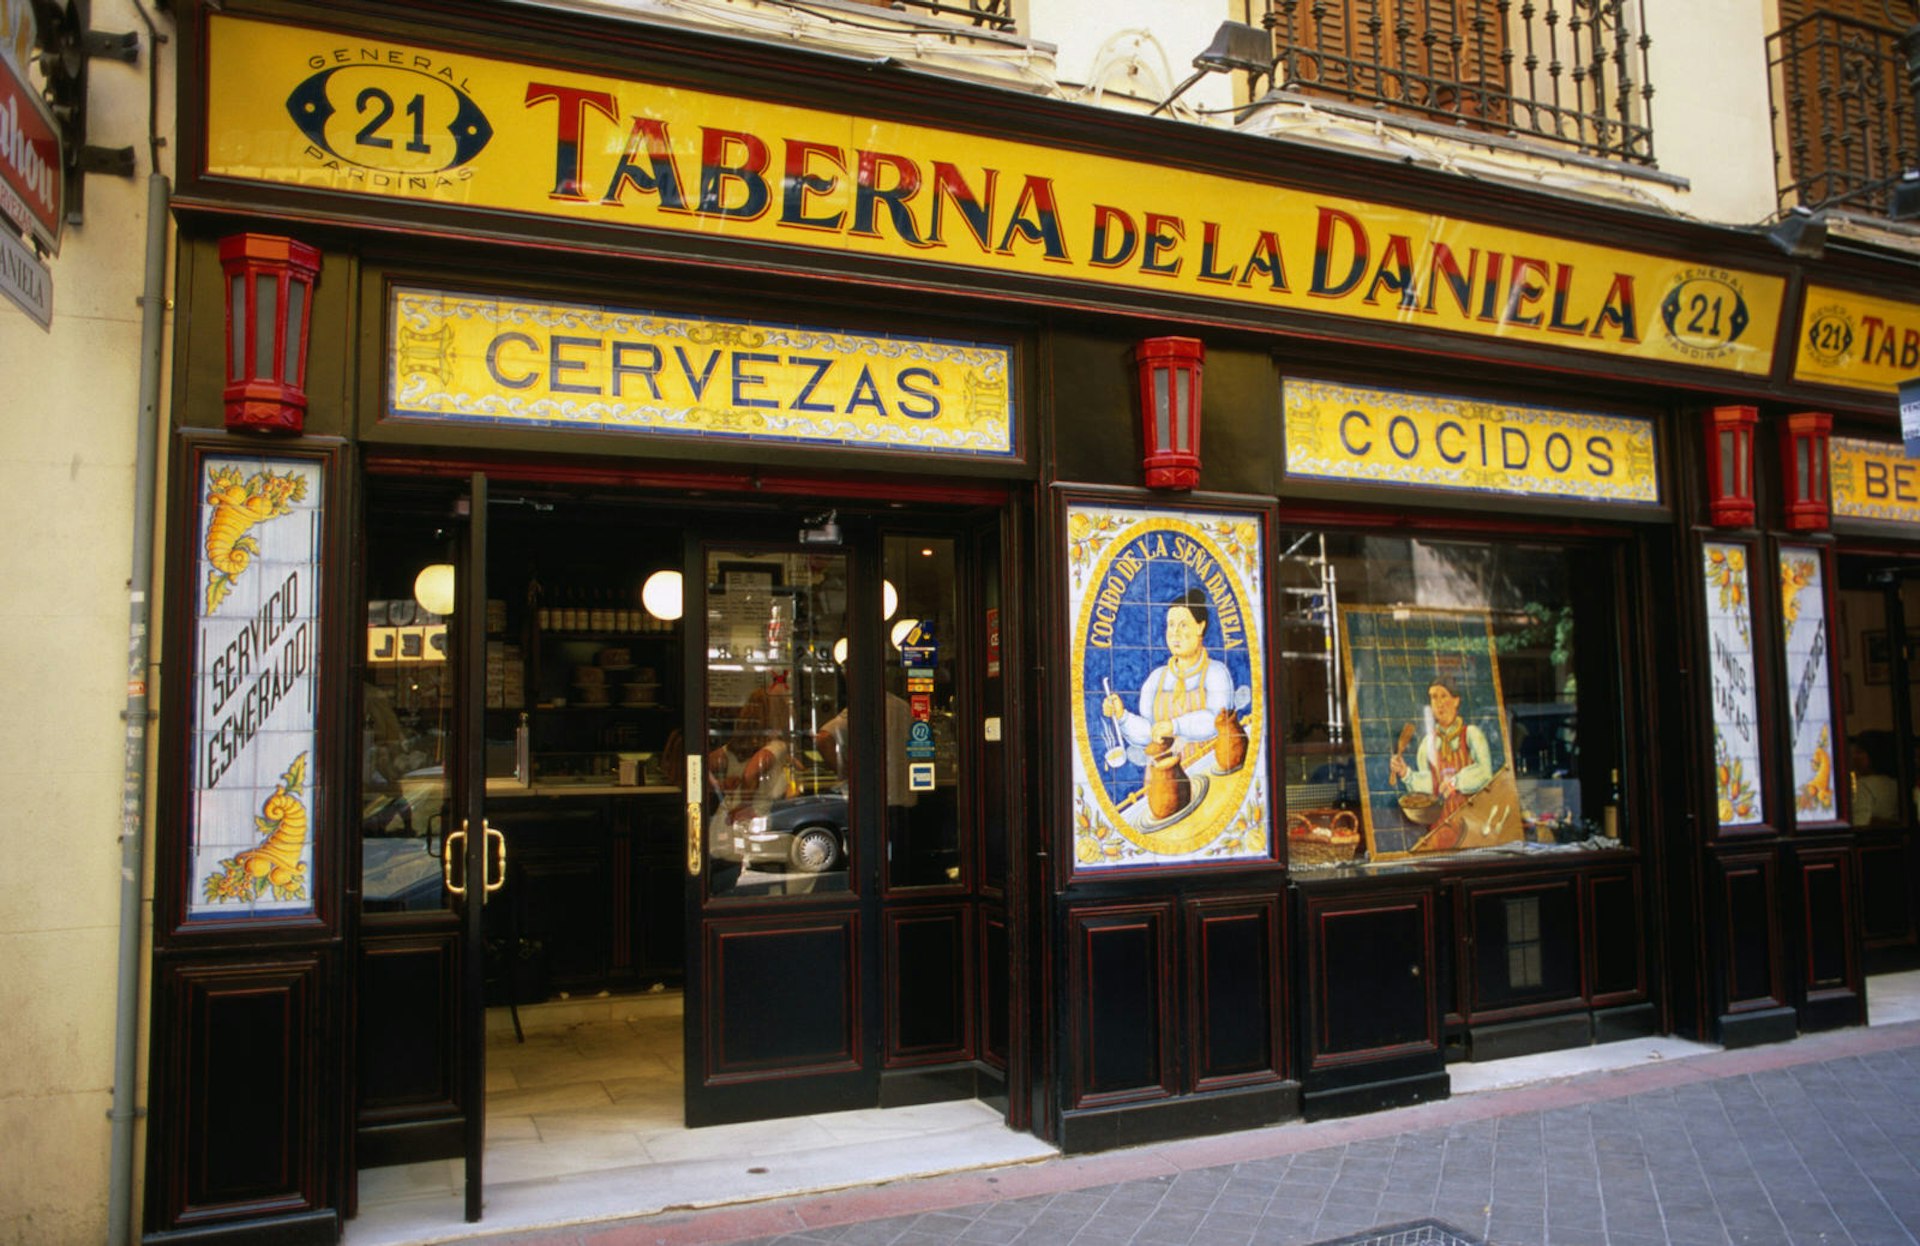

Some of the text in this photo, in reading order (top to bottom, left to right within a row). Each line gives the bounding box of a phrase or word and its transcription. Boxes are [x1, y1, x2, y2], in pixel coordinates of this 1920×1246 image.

[308, 48, 471, 94] GENERAL
[355, 86, 432, 155] 21
[303, 145, 474, 190] PARDIÑAS
[525, 81, 1642, 344] TABERNA DE LA DANIELA
[1687, 293, 1723, 336] 21
[1820, 322, 1842, 352] 21
[1861, 314, 1920, 371] TAB
[485, 330, 943, 421] CERVEZAS
[1339, 410, 1614, 477] COCIDOS
[1865, 460, 1919, 502] BE
[1090, 575, 1127, 648] COCIDO
[1115, 549, 1143, 582] DE
[1138, 534, 1168, 560] LA
[1204, 571, 1244, 650] DANIELA
[212, 570, 299, 717] SERVICIO
[1713, 631, 1748, 696] VINOS
[208, 621, 307, 790] ESMERADO
[1713, 675, 1750, 742] TAPAS
